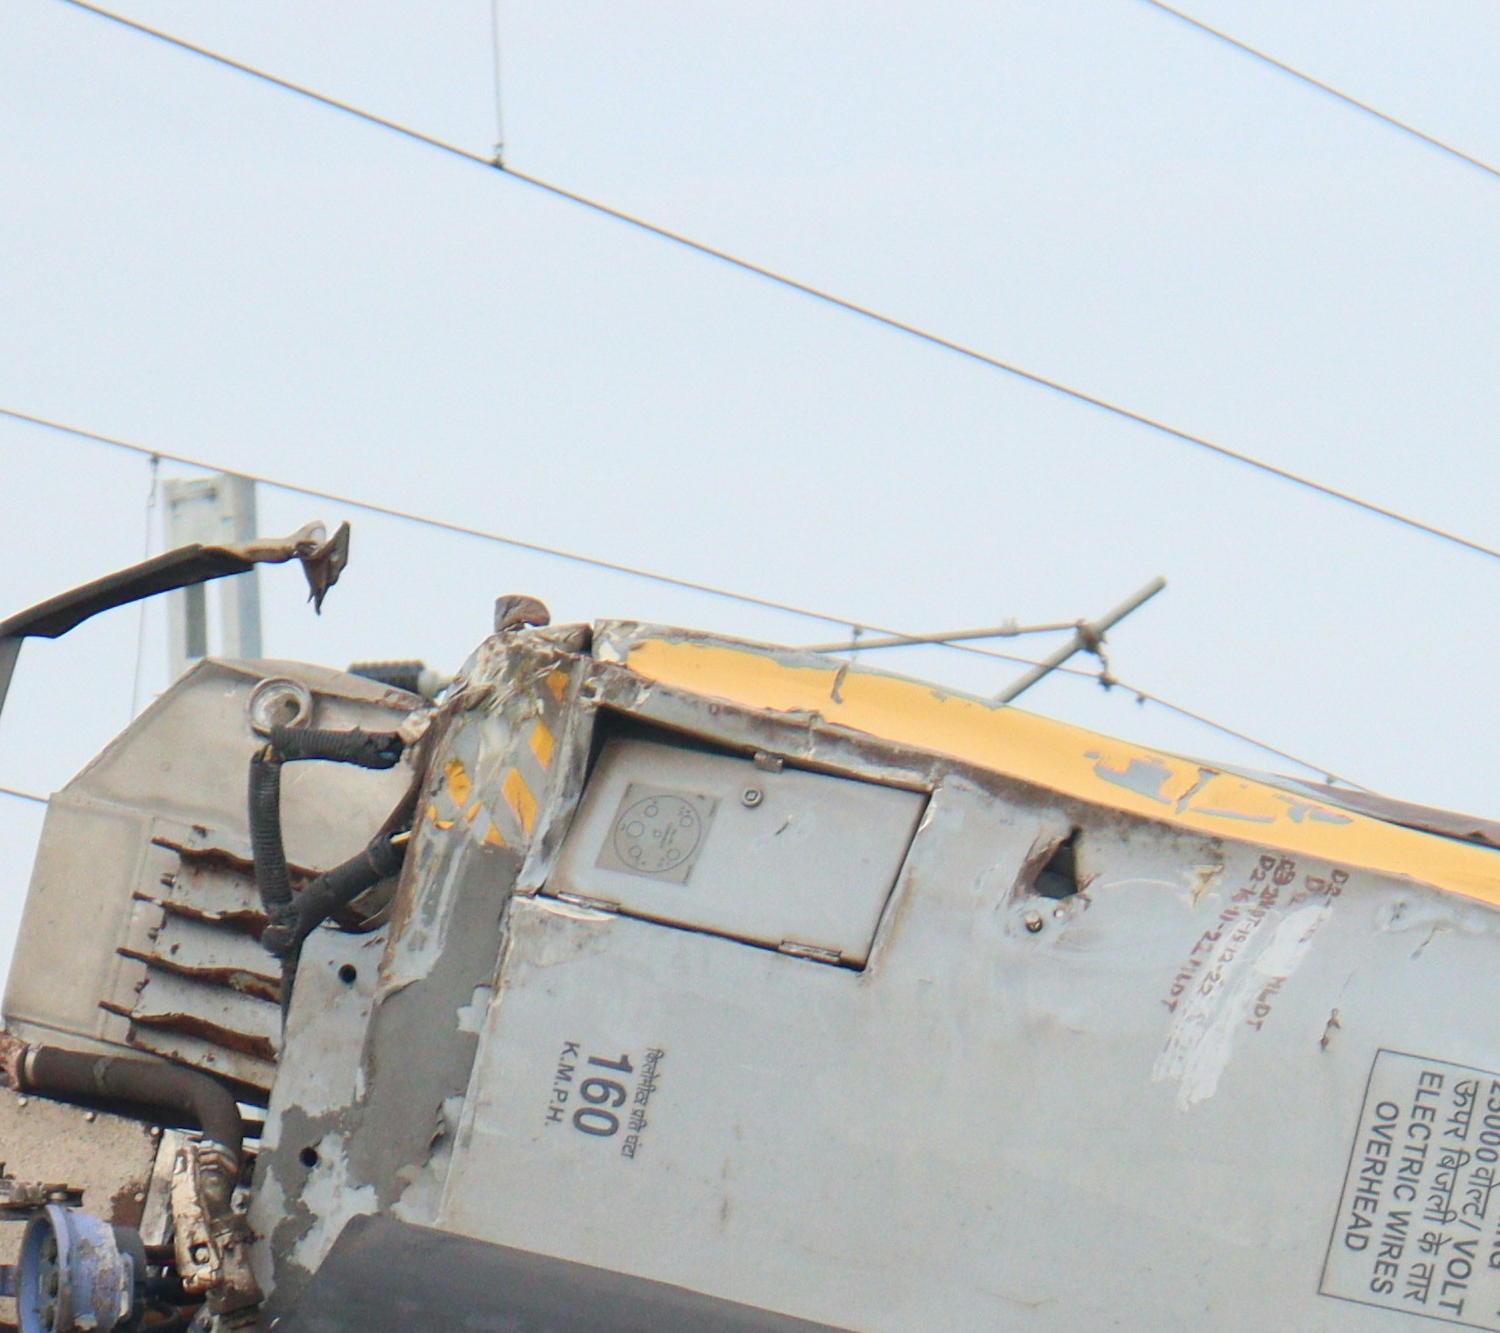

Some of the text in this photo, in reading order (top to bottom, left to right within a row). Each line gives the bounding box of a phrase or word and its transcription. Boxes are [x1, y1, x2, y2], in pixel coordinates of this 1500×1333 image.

[544, 1040, 581, 1126] K.M.P.H.
[572, 1054, 634, 1138] 160
[1344, 1100, 1400, 1252] OVERHEAD
[1369, 1070, 1445, 1295] ELECTRIC WIRES
[1403, 1079, 1481, 1305] ऊपर बिजली के तार
[1438, 1239, 1479, 1317] VOLT
